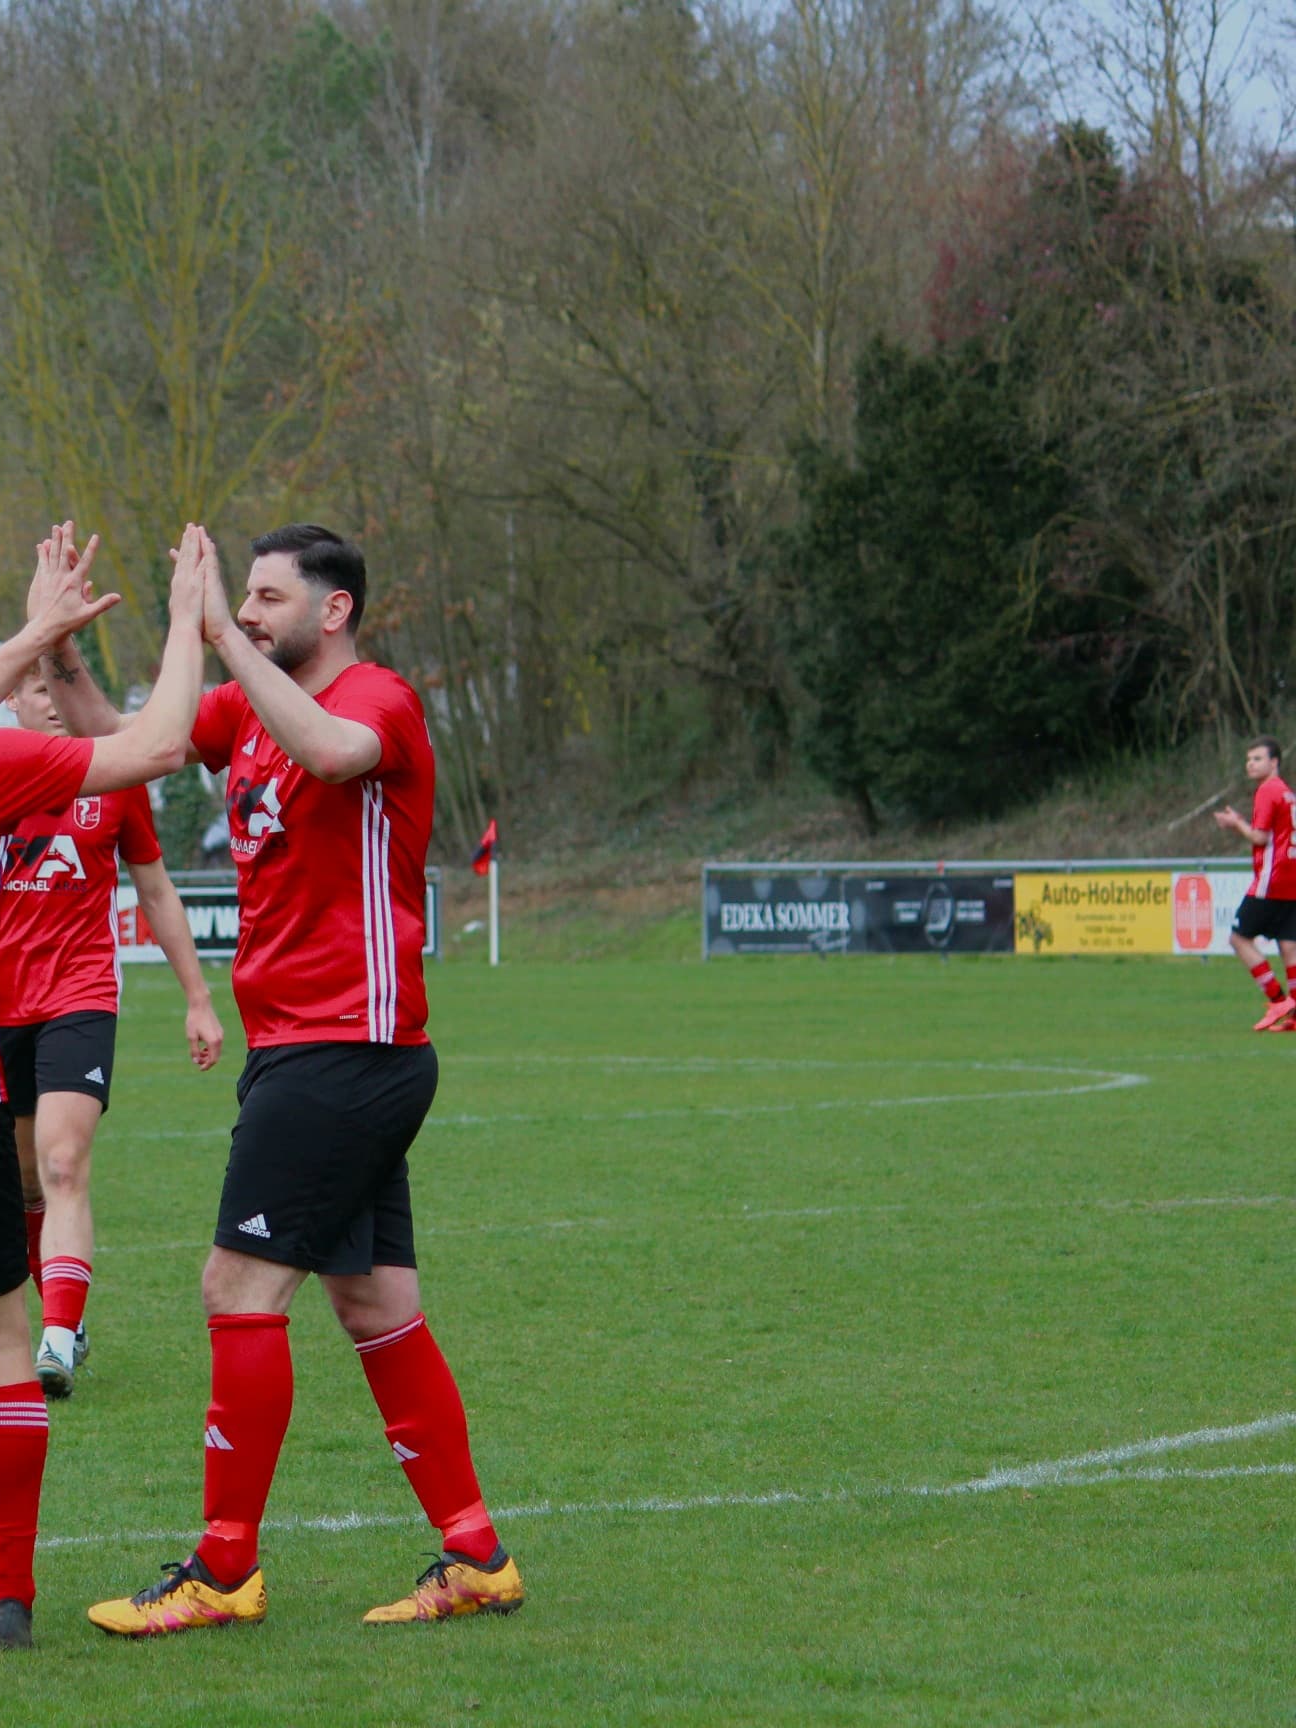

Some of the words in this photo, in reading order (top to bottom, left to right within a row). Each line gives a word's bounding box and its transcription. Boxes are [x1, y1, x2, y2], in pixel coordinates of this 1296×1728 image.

[1041, 879, 1170, 906] Auto-Holzhofer
[720, 902, 774, 931] EDEKA
[775, 901, 850, 931] SOMMER
[238, 1222, 271, 1239] adidas
